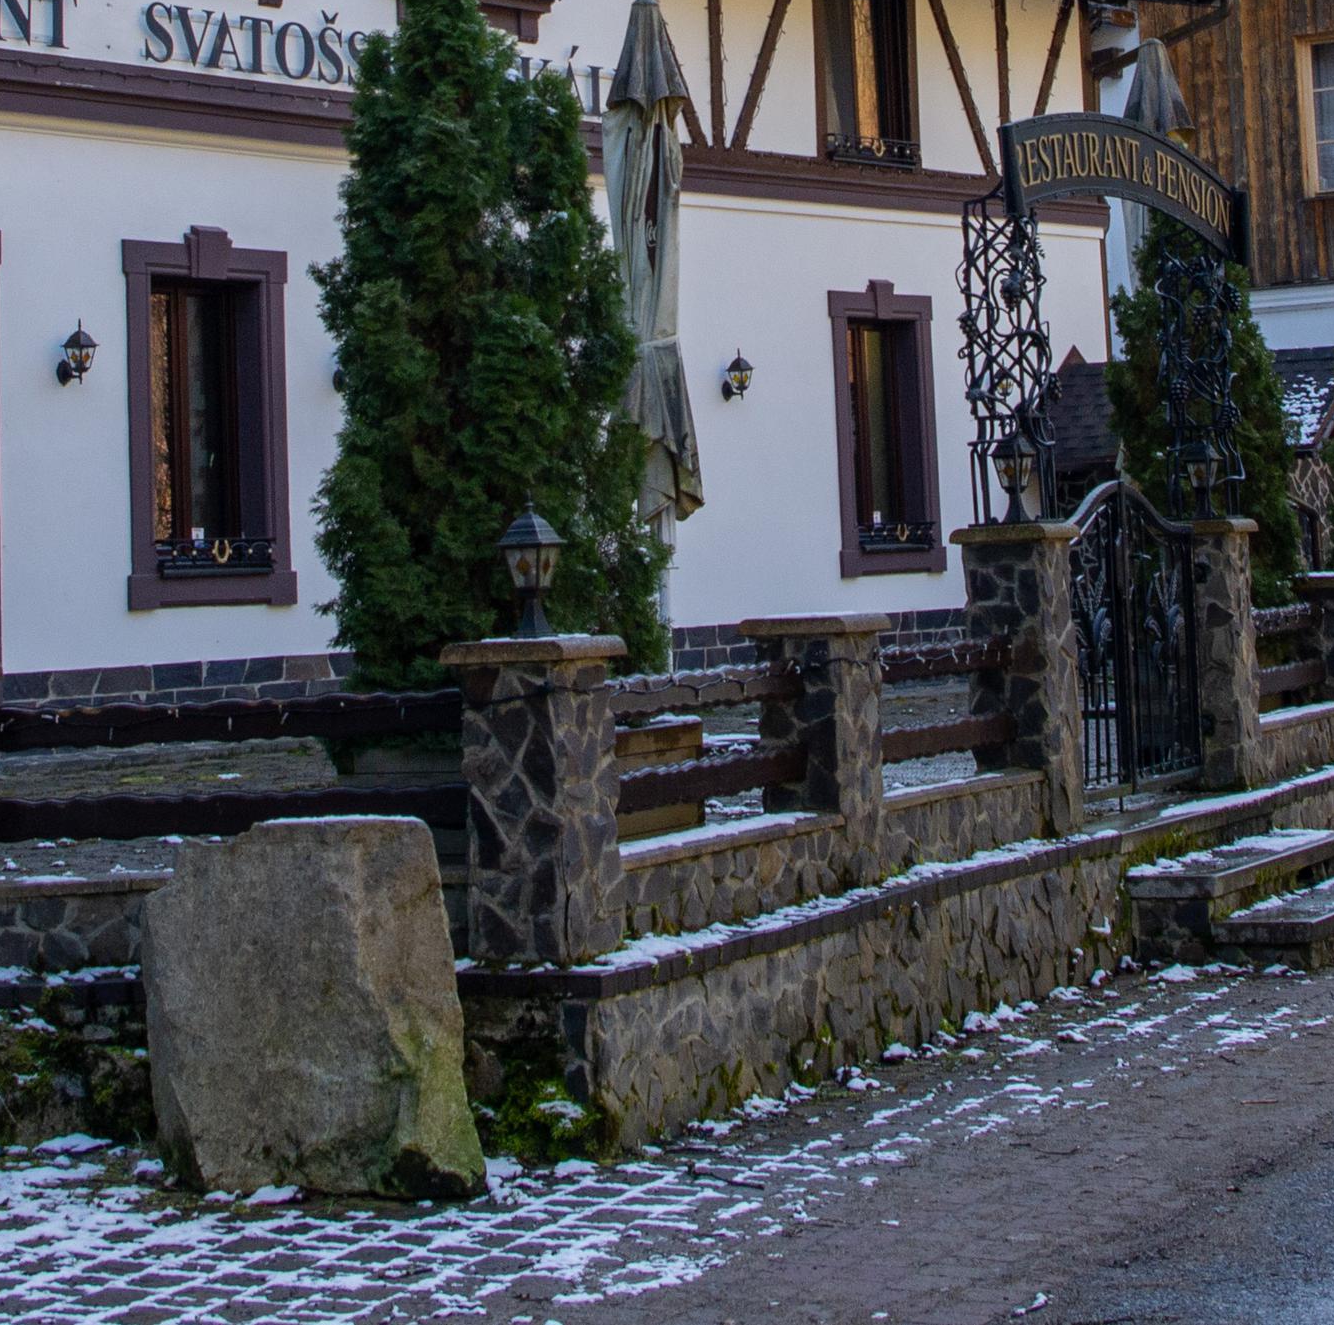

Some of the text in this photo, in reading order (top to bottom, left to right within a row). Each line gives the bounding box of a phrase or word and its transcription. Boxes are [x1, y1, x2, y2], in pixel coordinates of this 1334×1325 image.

[144, 1, 371, 89] SVATOŠS
[1142, 156, 1153, 186] &
[1154, 149, 1231, 238] PENSION
